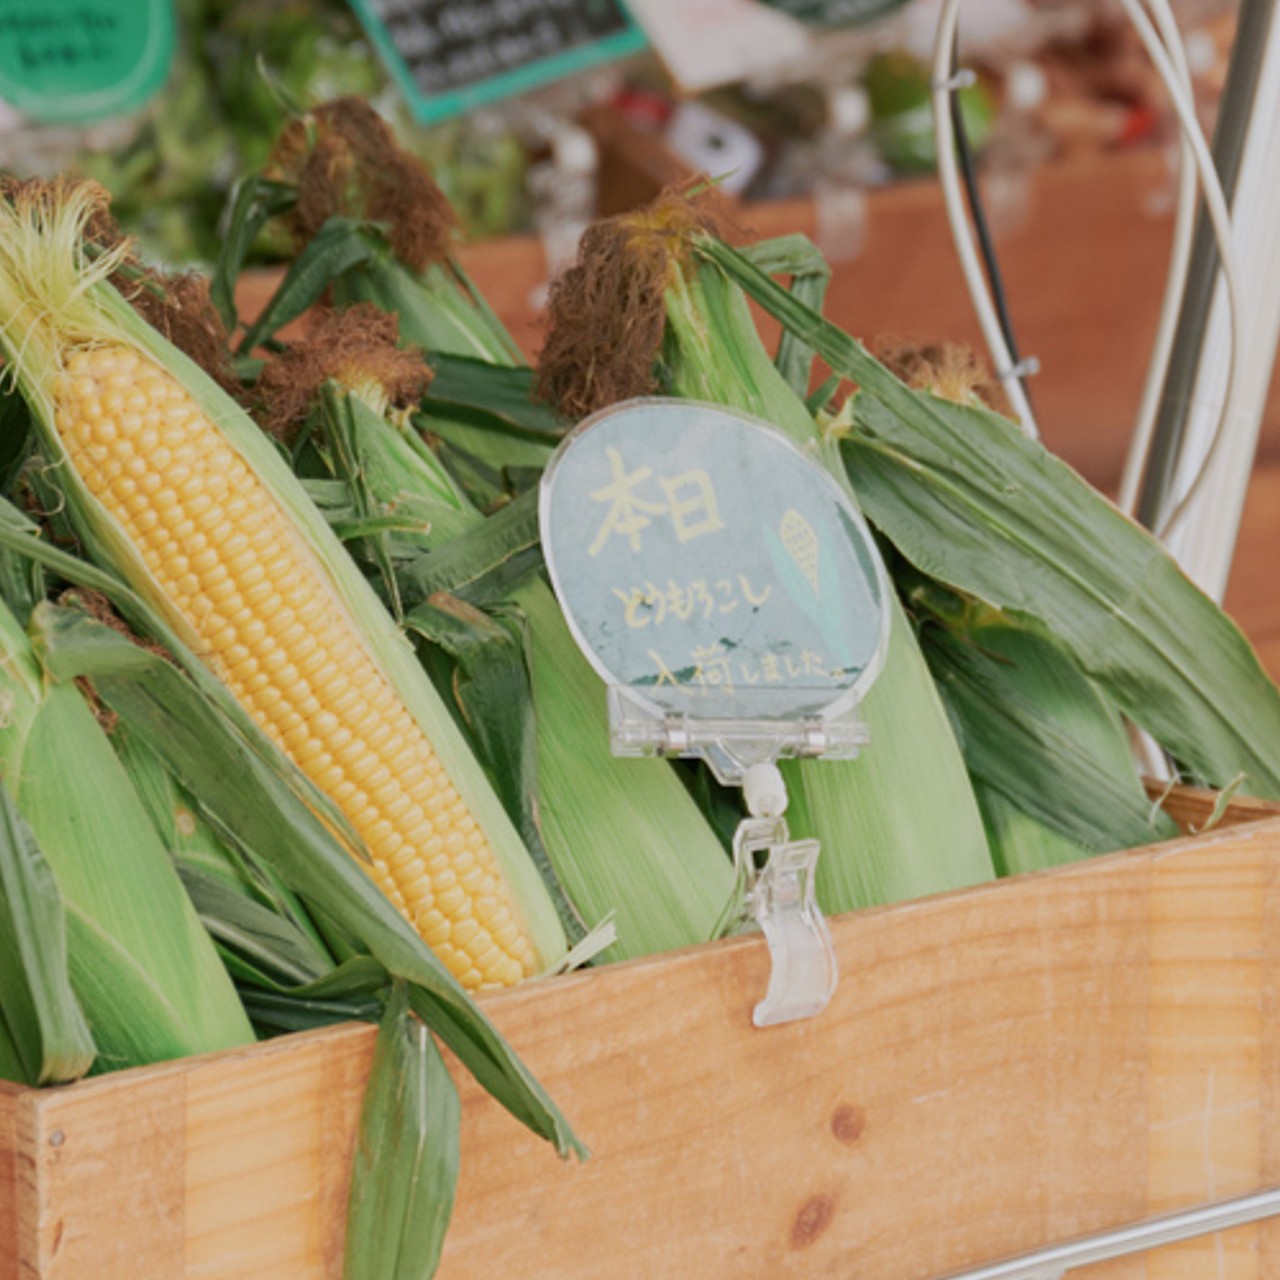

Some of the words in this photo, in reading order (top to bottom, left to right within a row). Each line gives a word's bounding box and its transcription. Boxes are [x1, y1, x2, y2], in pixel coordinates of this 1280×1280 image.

[587, 446, 726, 558] 本日
[612, 573, 774, 629] とうもろこし
